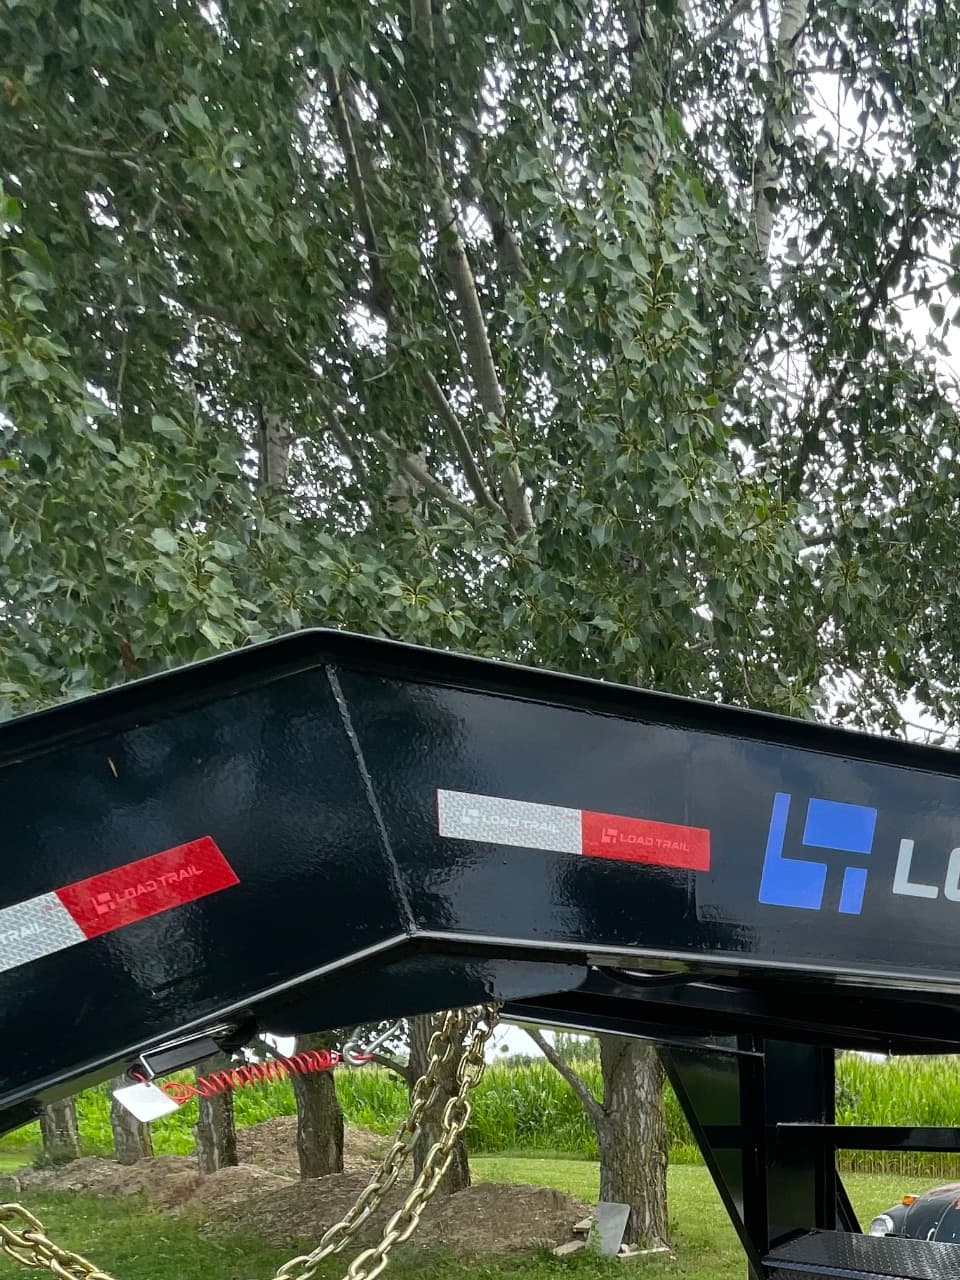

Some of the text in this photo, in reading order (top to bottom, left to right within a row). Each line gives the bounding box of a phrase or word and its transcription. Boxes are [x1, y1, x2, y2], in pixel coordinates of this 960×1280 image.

[620, 833, 654, 846] LOAD
[655, 838, 689, 851] TRAIL
[115, 880, 158, 903] LOAD
[157, 865, 203, 886] TRAIL
